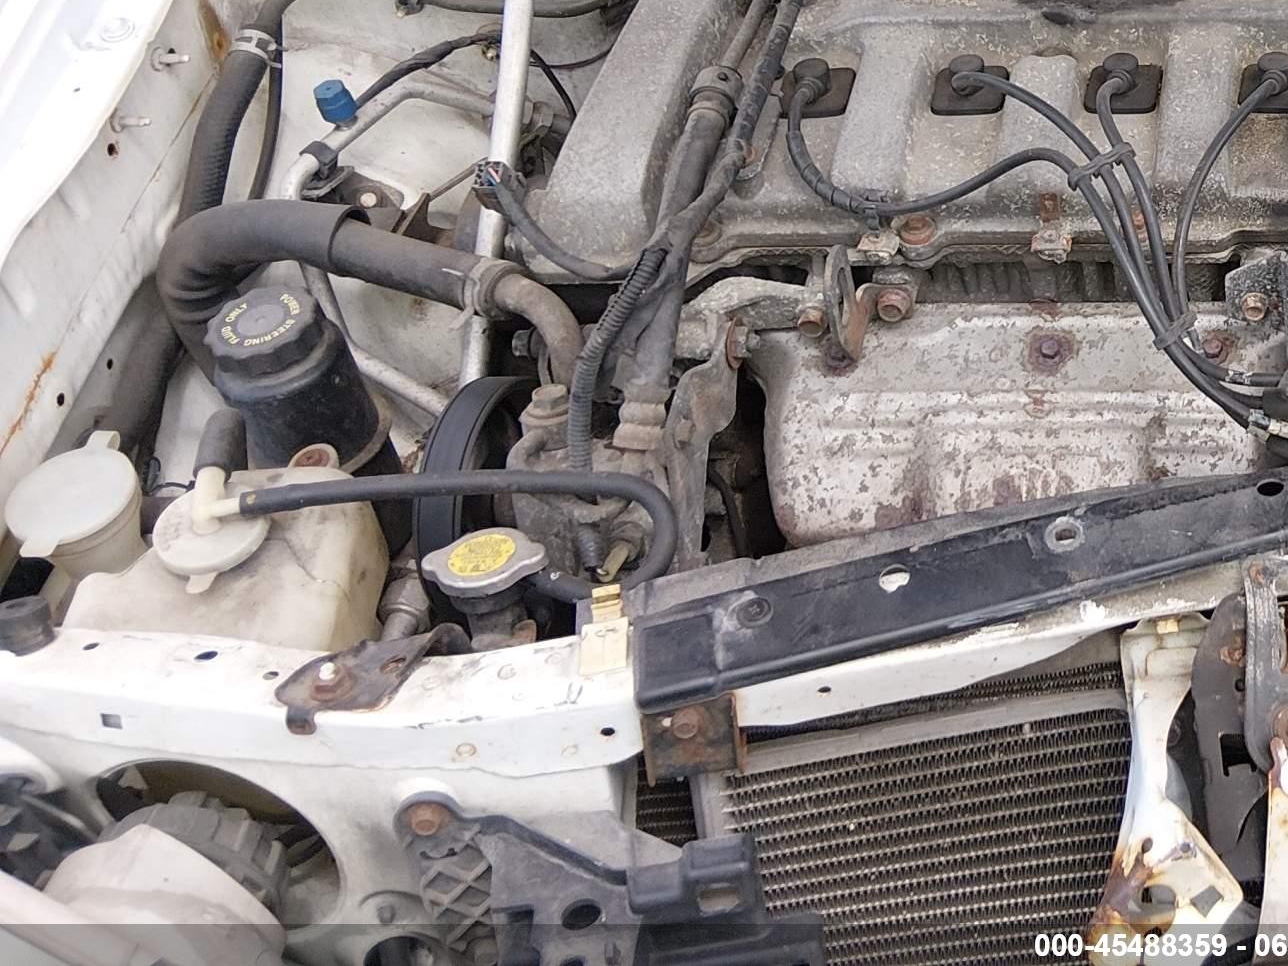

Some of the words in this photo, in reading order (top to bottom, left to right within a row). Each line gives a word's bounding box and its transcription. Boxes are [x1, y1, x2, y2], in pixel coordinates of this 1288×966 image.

[224, 302, 248, 323] ONLY
[280, 293, 301, 315] POWER
[220, 325, 240, 345] FLUID
[243, 318, 296, 347] STEERING
